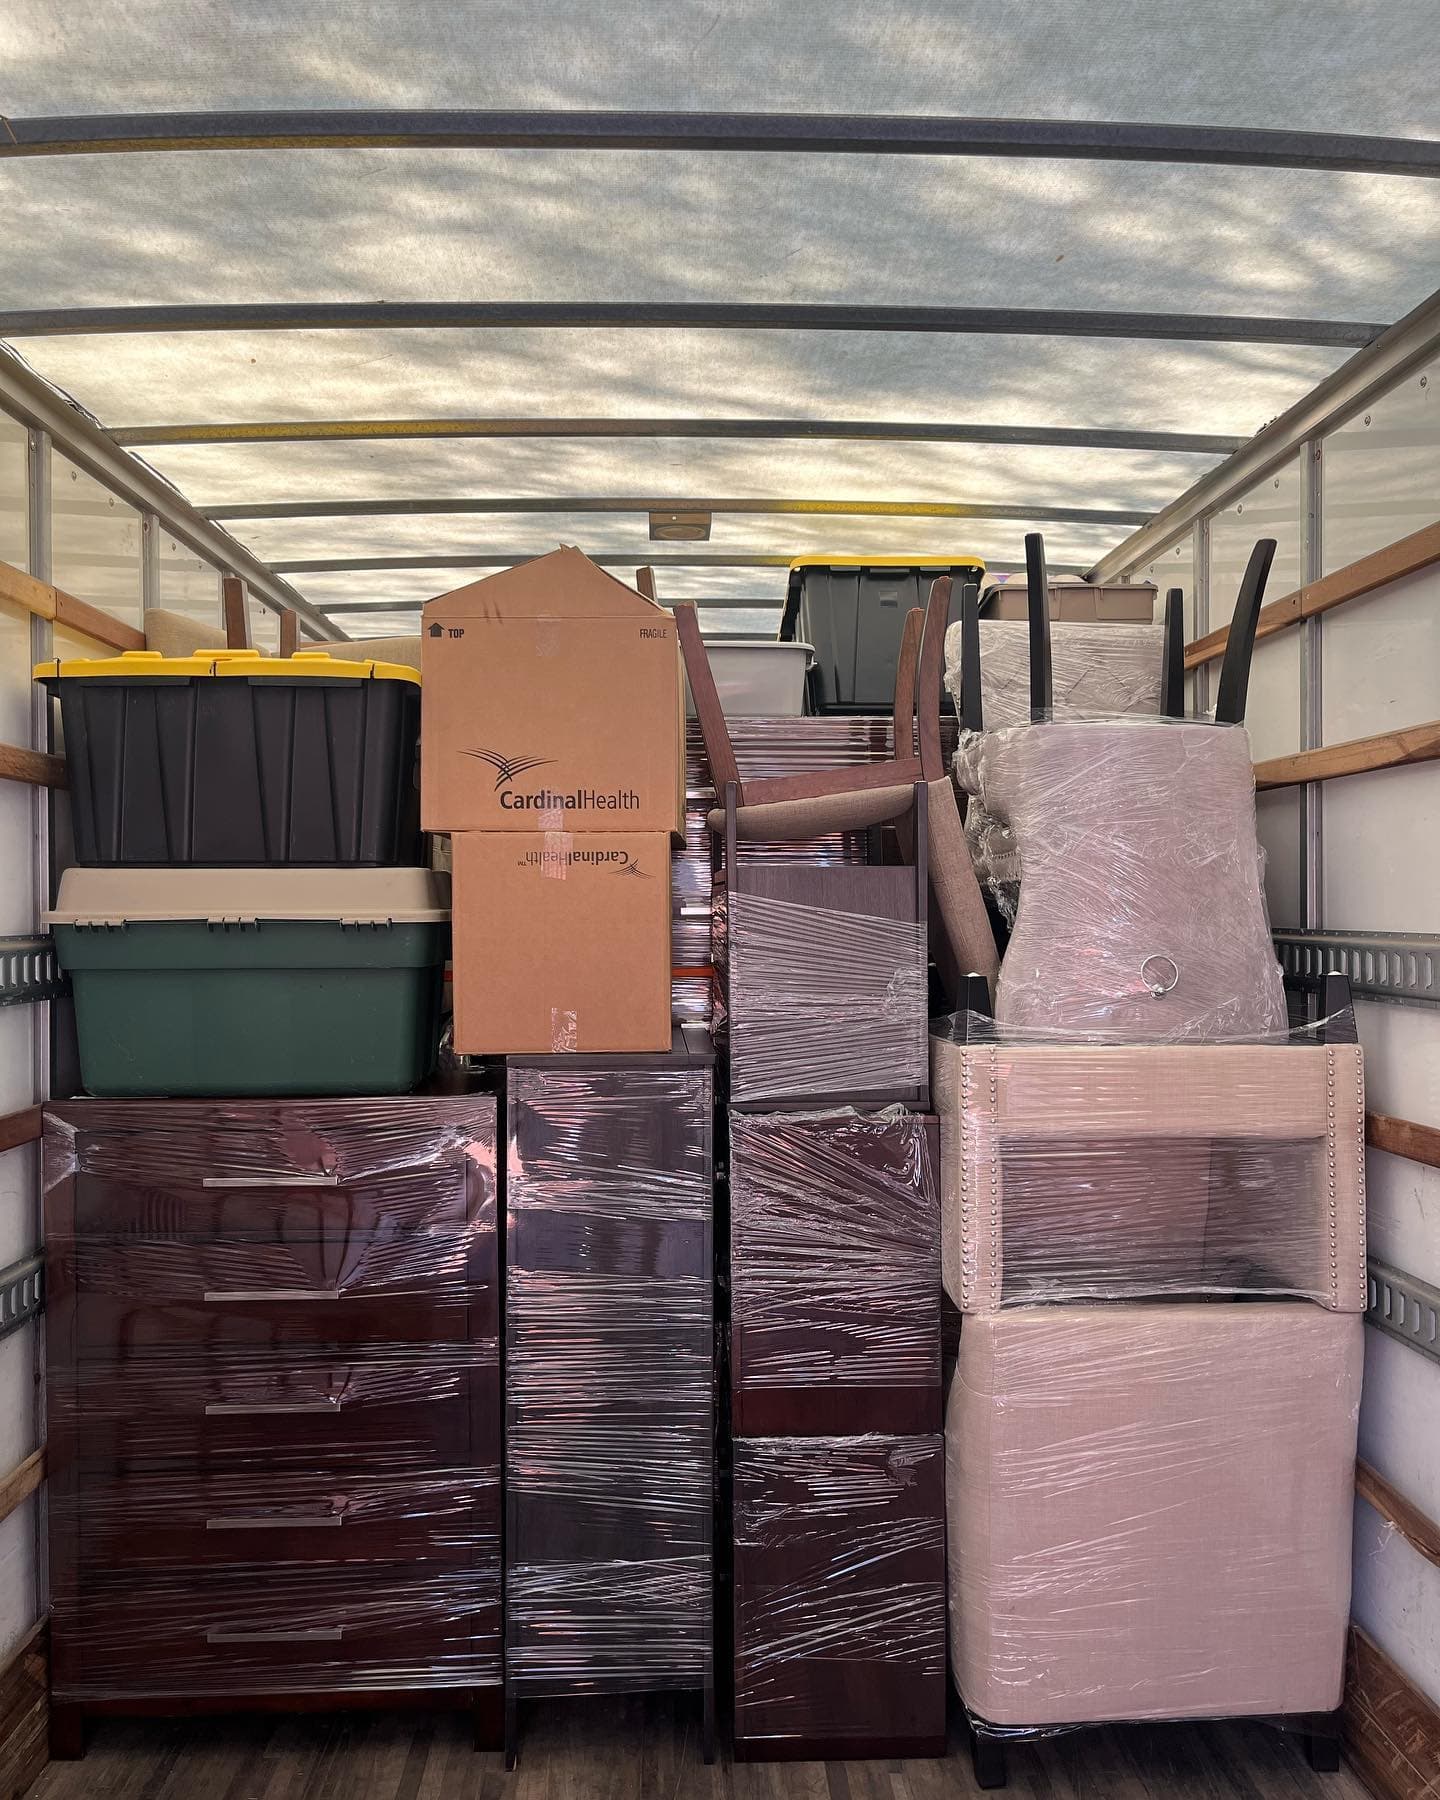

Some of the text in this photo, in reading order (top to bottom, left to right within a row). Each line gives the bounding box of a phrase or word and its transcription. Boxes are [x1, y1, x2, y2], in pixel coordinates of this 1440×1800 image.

[448, 628, 465, 639] TOP
[639, 628, 668, 639] FRAGILE
[500, 789, 640, 810] CardinalHealth
